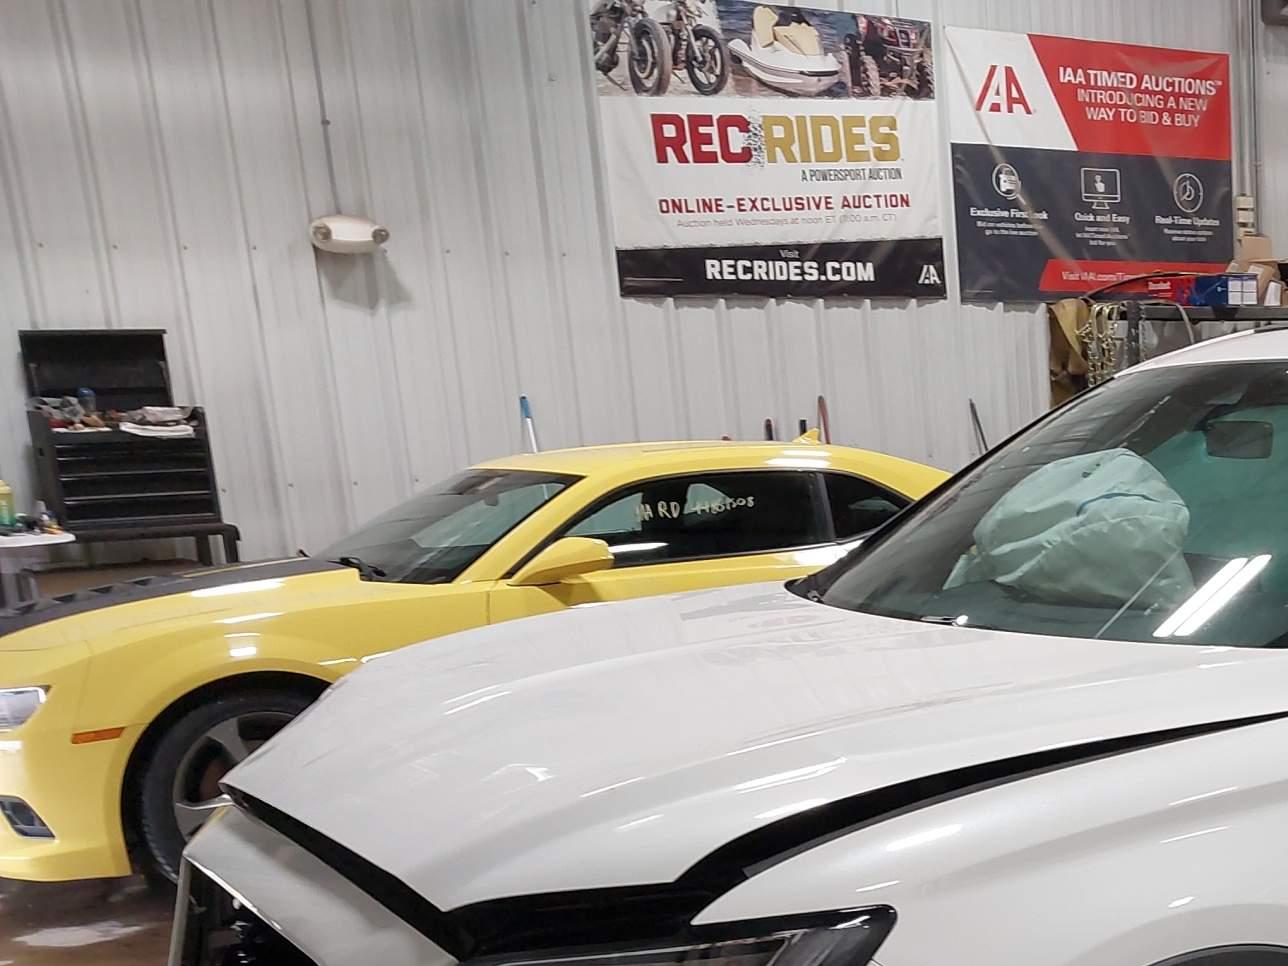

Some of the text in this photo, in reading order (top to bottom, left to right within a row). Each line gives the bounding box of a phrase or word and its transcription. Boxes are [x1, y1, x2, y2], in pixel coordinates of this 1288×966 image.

[1059, 67, 1086, 84] IAA
[1089, 70, 1136, 89] TIMED
[1077, 88, 1208, 112] INTRODUCING A NEW
[1086, 106, 1201, 127] WAY TO BID & BUY
[650, 113, 902, 164] REC RIDES
[801, 167, 903, 183] A POWERSPORT AUCTION
[659, 194, 911, 214] ONLINE-EXCLUSIVE AUCTION
[780, 249, 800, 259] Visit
[705, 260, 875, 282] RECRIDES.COM
